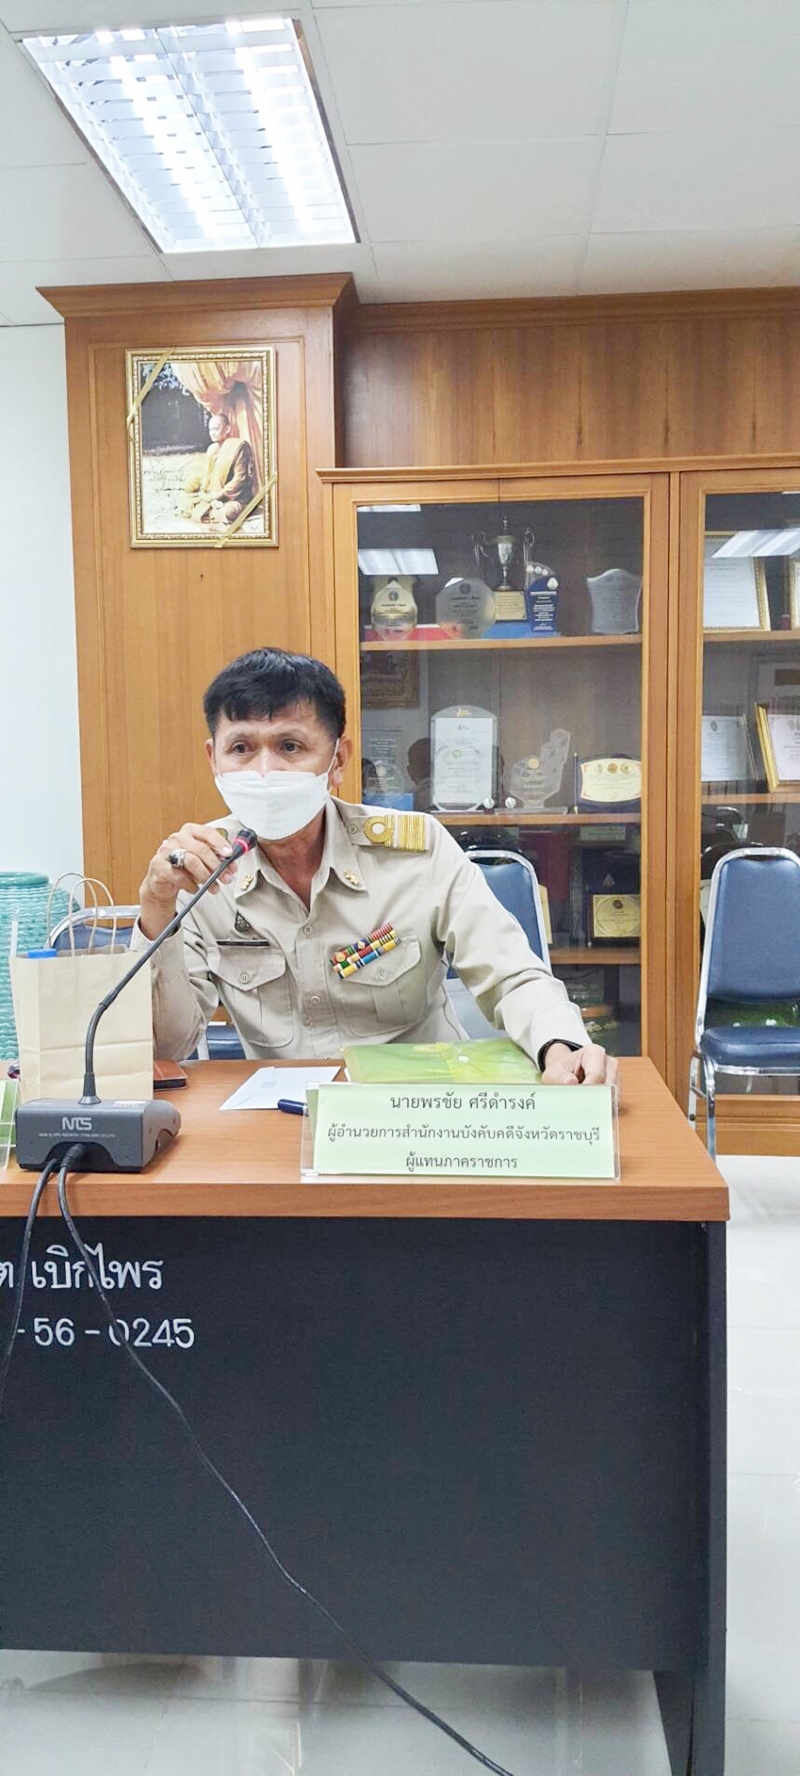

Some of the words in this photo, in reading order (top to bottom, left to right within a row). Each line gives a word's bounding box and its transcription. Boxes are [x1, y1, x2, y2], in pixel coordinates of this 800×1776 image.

[390, 1091, 462, 1109] นายพรชัย
[469, 1091, 536, 1110] ศรีดำรงค์
[327, 1122, 600, 1146] ผู้อำนวยการสำนักงานบังคับคดีจังหวัดราชบุรี
[406, 1150, 518, 1172] ผู้แทนภาคราชการ
